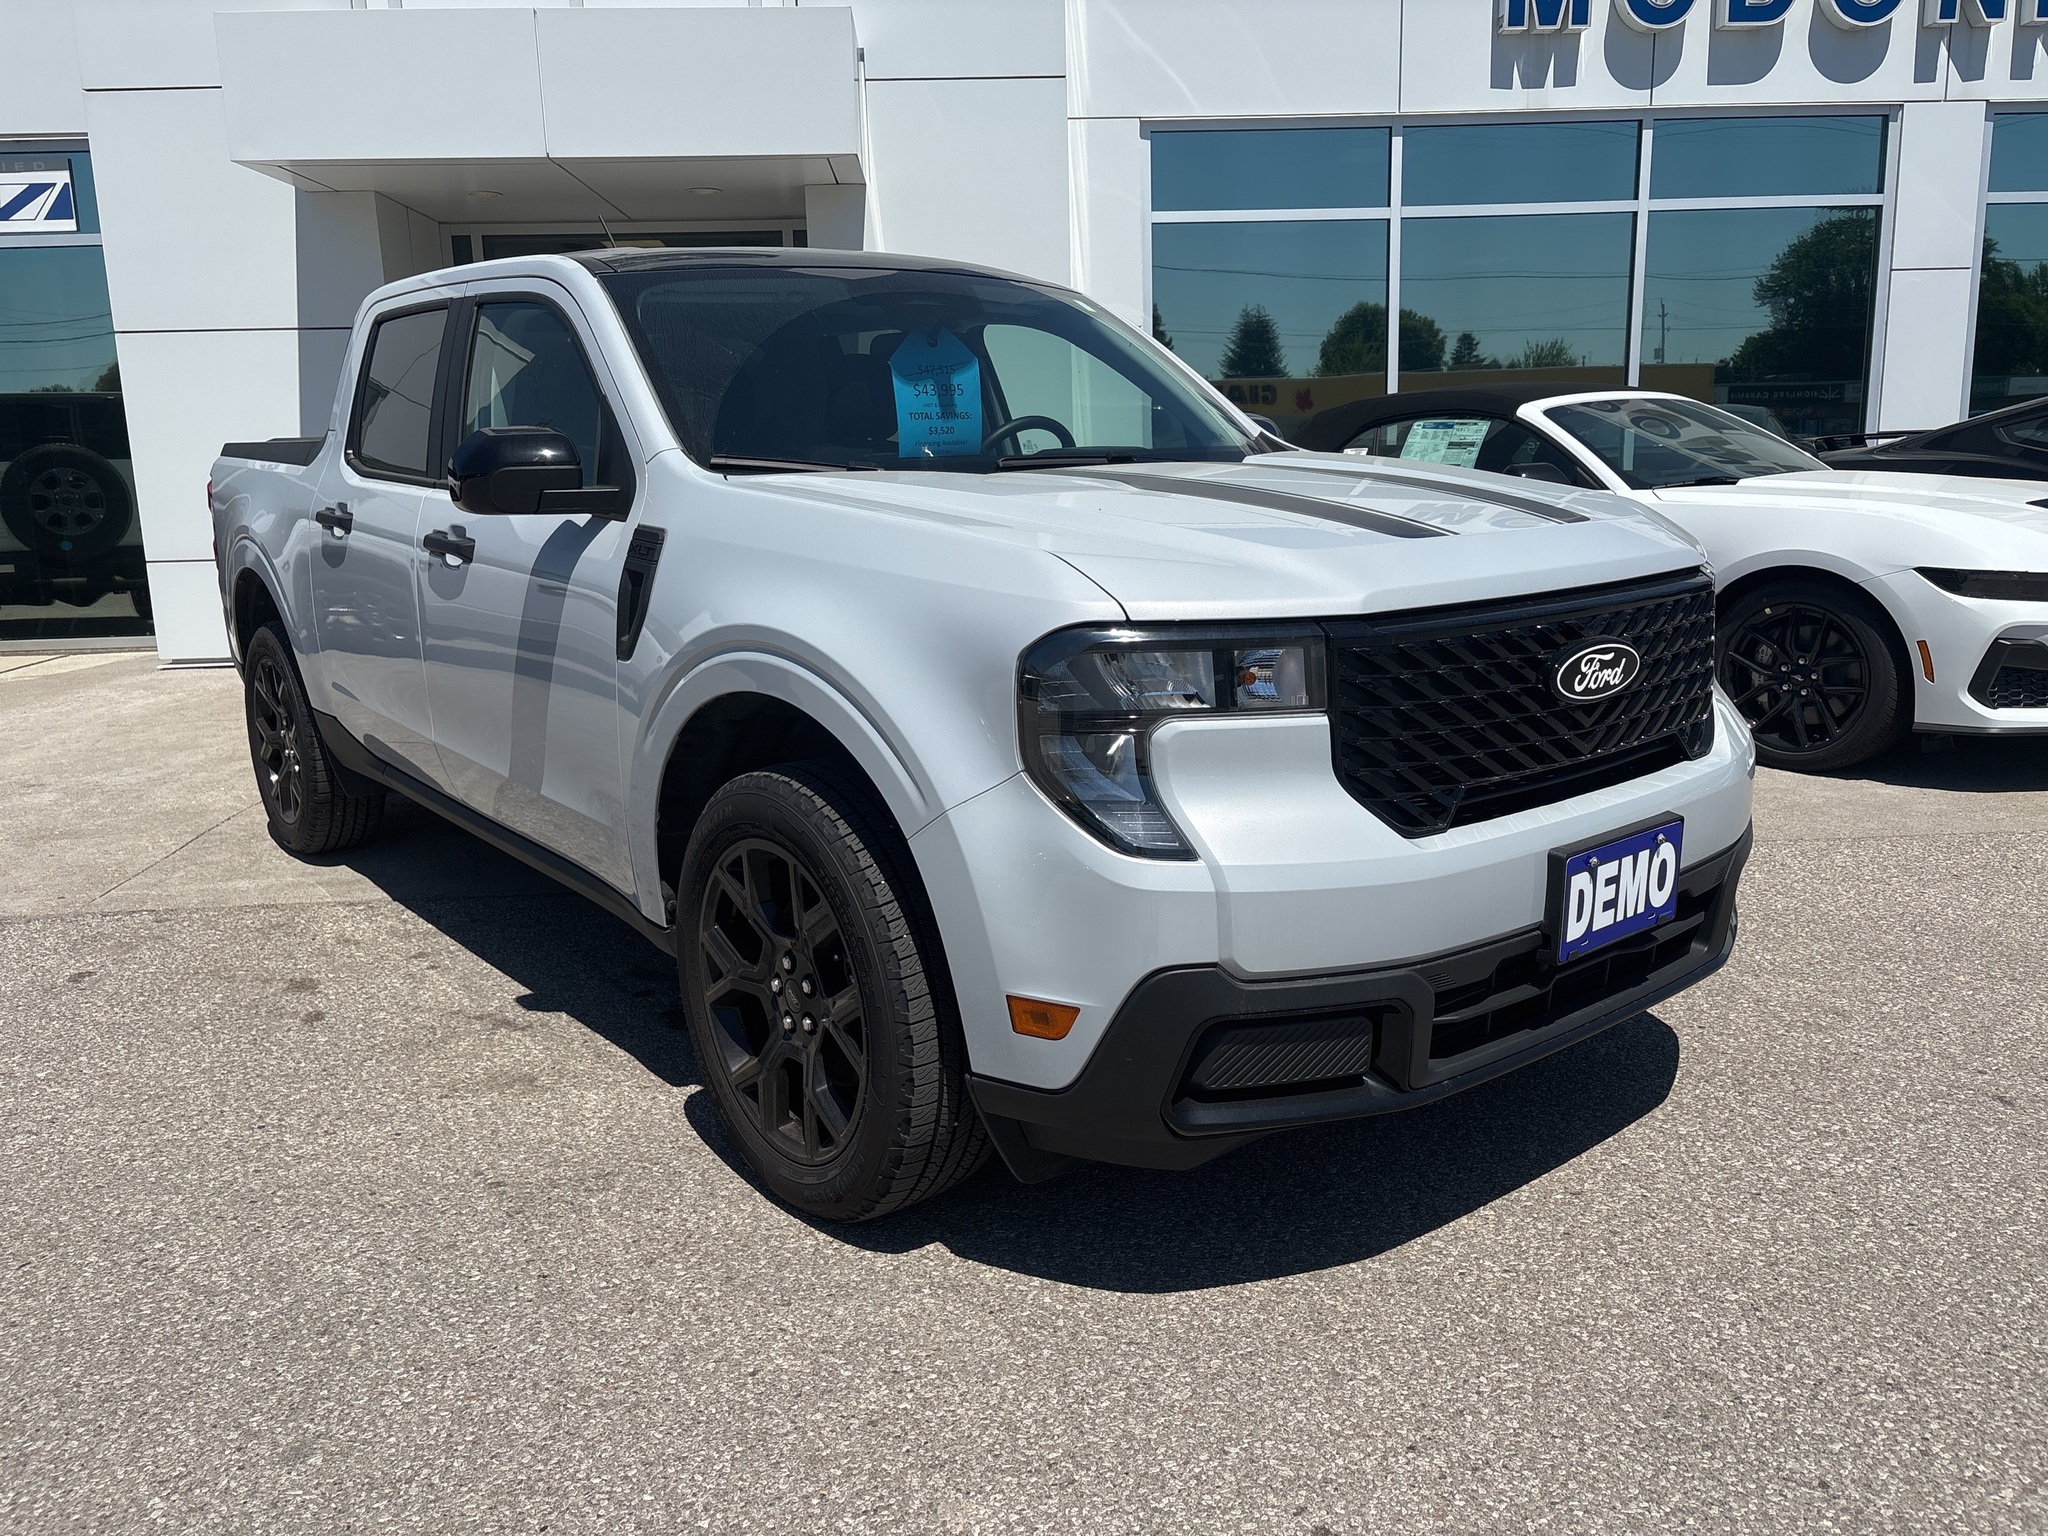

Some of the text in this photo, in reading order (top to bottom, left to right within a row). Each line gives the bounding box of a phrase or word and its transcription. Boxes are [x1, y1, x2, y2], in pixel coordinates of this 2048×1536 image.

[917, 364, 956, 375] $47,515
[913, 383, 964, 397] $43,995
[909, 411, 972, 421] TOTAL SAVINGS:
[928, 426, 955, 435] $3,520
[915, 440, 941, 448] Financing
[629, 544, 655, 556] XLT
[1574, 651, 1627, 693] Ford
[1566, 841, 1676, 943] DEMO
